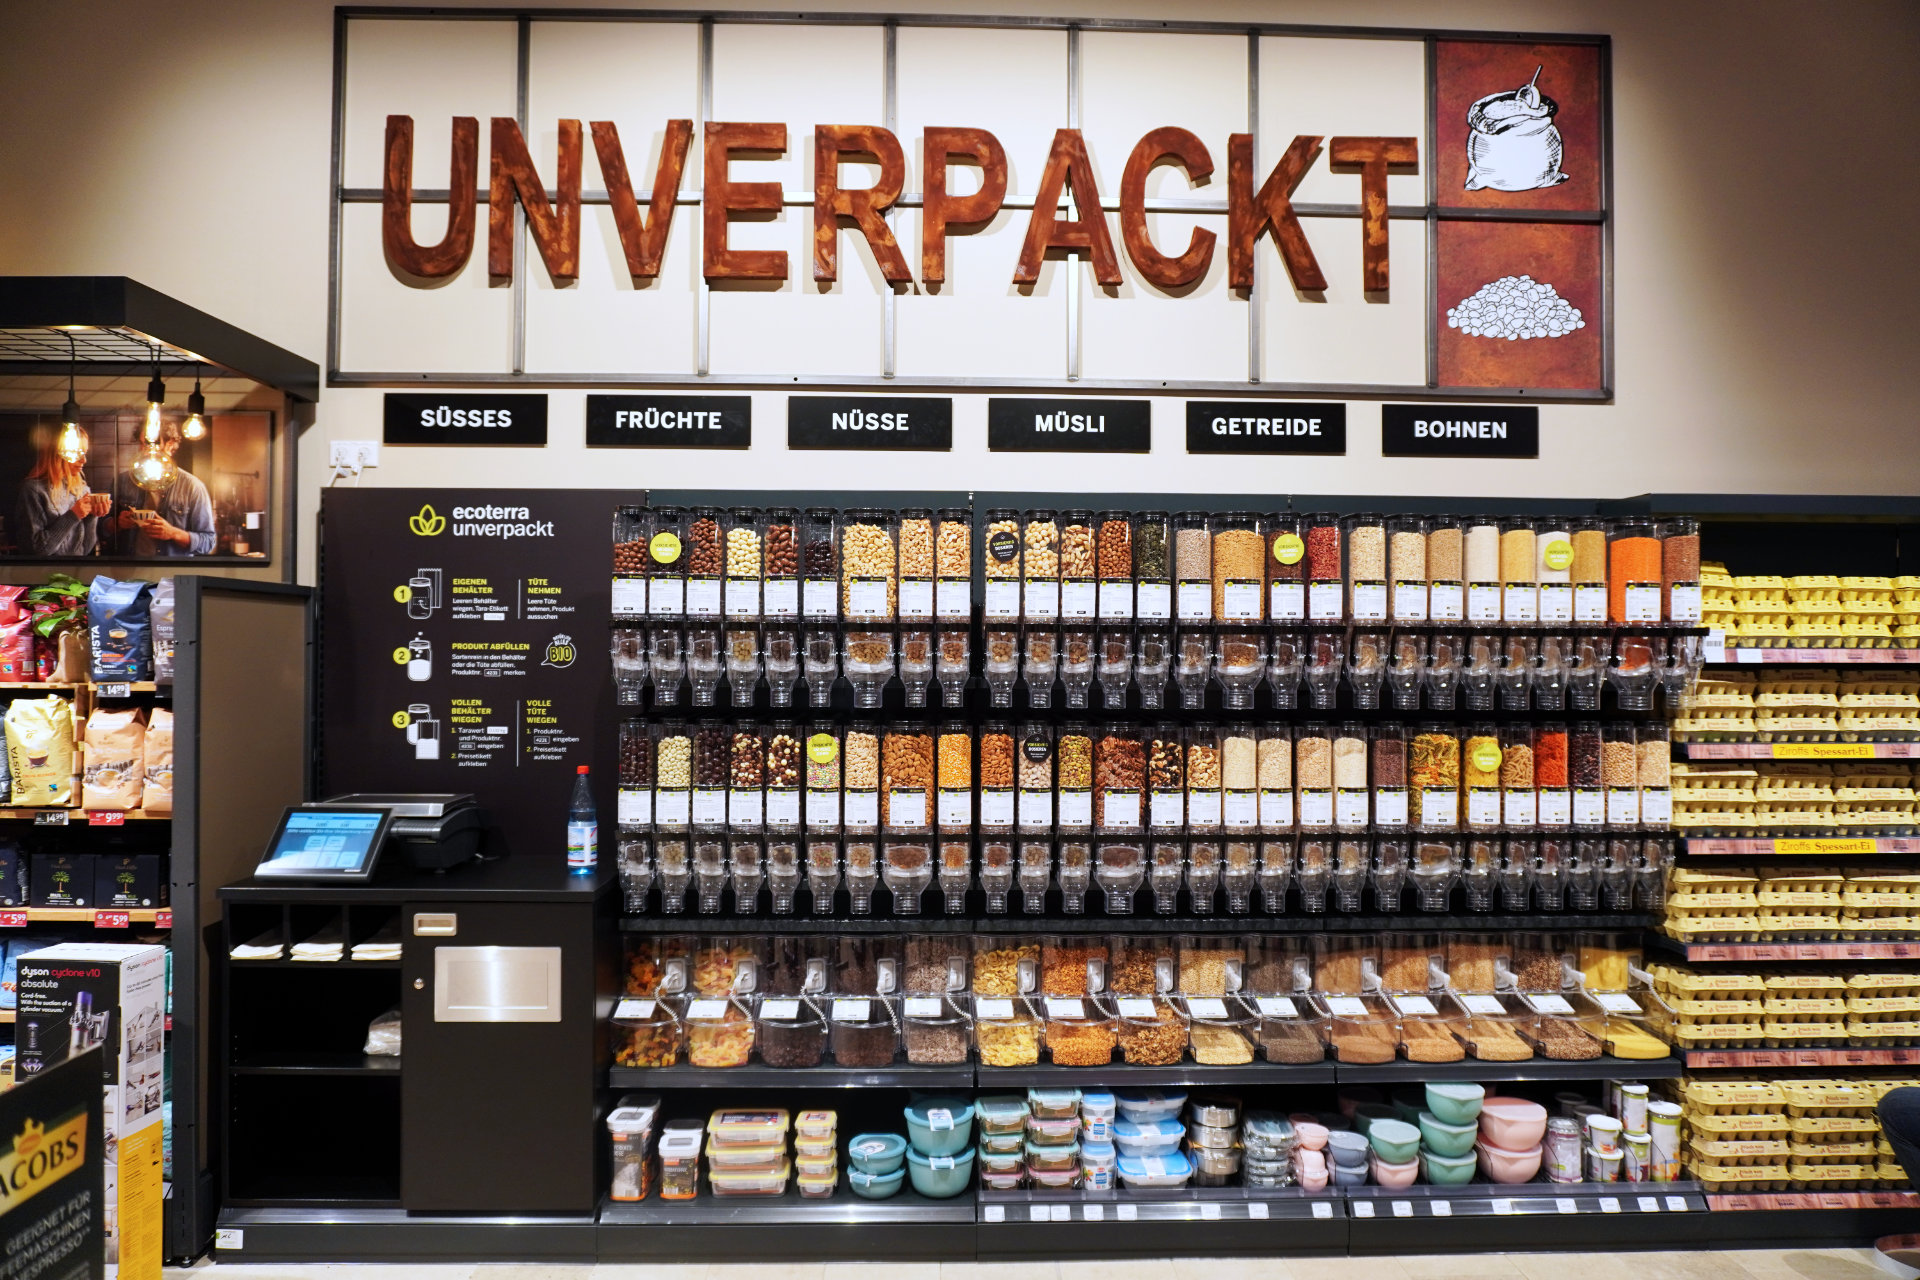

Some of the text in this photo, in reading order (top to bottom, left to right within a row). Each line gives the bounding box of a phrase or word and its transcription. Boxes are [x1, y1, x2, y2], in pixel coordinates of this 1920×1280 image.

[382, 114, 1418, 293] UNVERPACKT
[420, 405, 512, 429] SÜSSES
[616, 407, 722, 430] FRÜCHTE
[832, 408, 909, 432] NÜSSE
[1035, 409, 1105, 433] MÜSLI
[1212, 416, 1322, 437] GETREIDE
[1414, 419, 1507, 440] BOHNEN
[452, 504, 530, 520] ecoterra
[453, 520, 554, 540] unverpackt
[528, 578, 548, 586] TÜTE
[398, 589, 406, 599] 1
[90, 625, 104, 674] BARISTA
[490, 642, 530, 650] ABFÜLLEN
[550, 646, 572, 662] BIO
[398, 651, 406, 661] 2
[397, 715, 406, 725] 3
[1779, 746, 1868, 758] Ziroffs Spessart-Ei
[11, 746, 26, 795] BARISTA
[1780, 842, 1870, 852] Ziroffs Spessart-Ei
[20, 966, 49, 978] dyson
[51, 968, 84, 978] cyclone
[86, 968, 100, 978] v10
[20, 980, 58, 988] absolute
[6, 1190, 91, 1256] GEEIGNET FÜR
